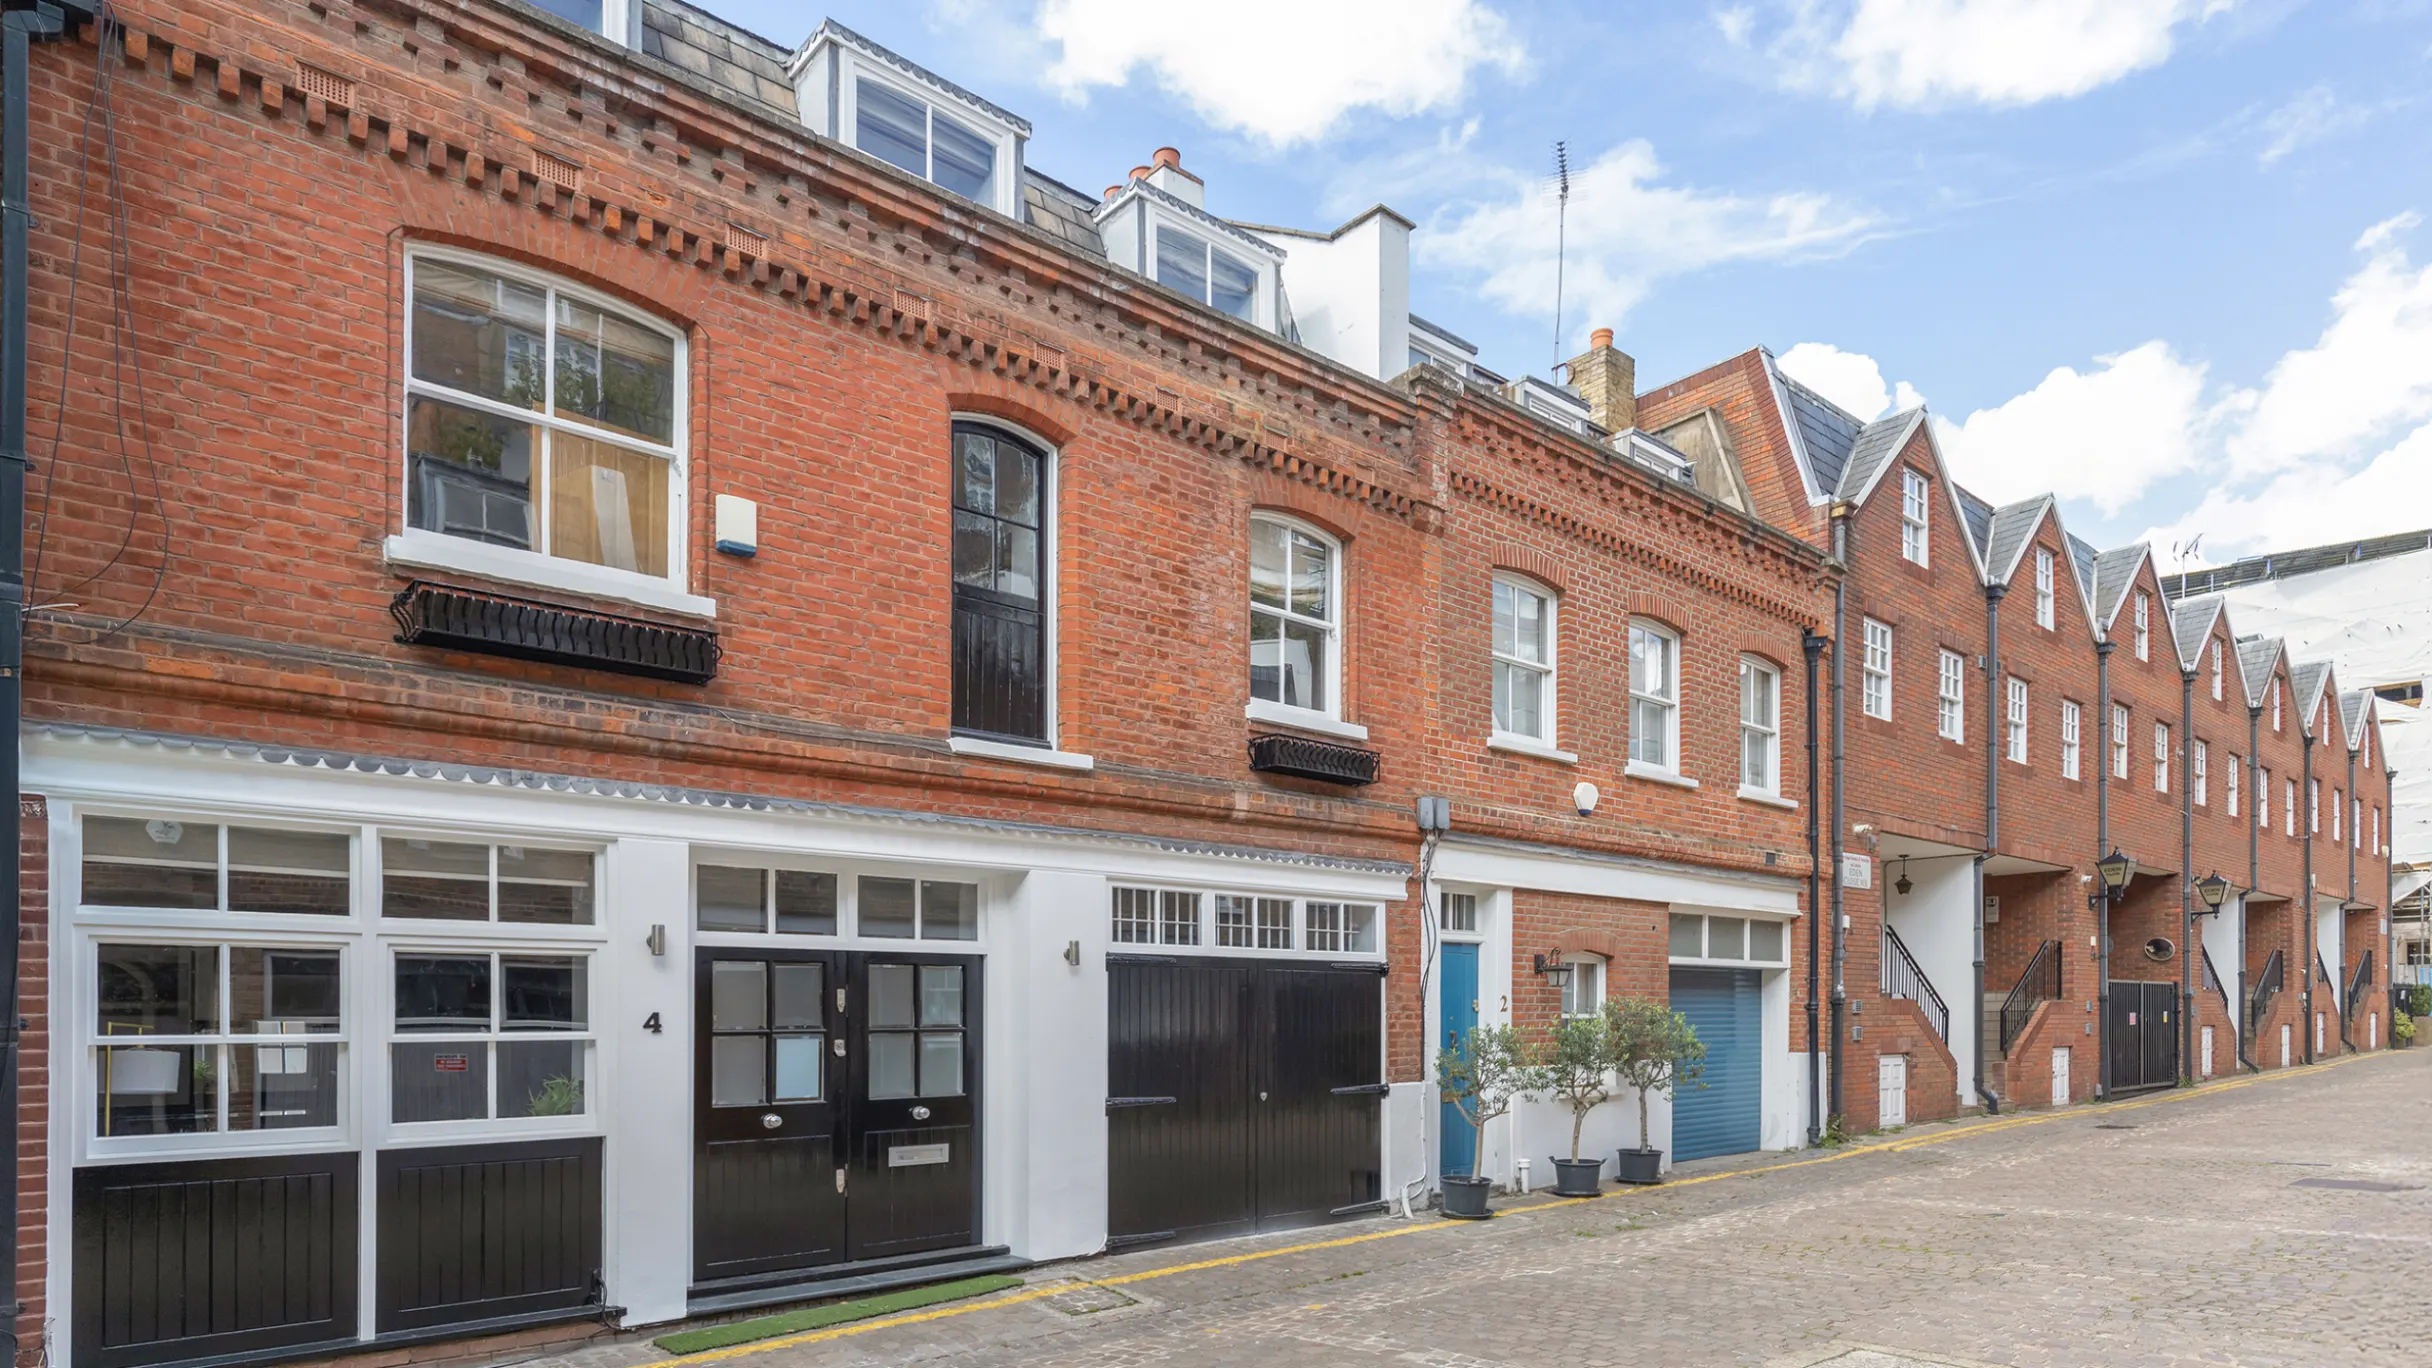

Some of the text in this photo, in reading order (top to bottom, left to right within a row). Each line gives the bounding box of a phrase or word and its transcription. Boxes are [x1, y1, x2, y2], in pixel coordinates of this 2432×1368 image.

[1849, 868, 1863, 877] EDEN
[1500, 995, 1508, 1012] 2
[643, 1012, 662, 1033] 4
